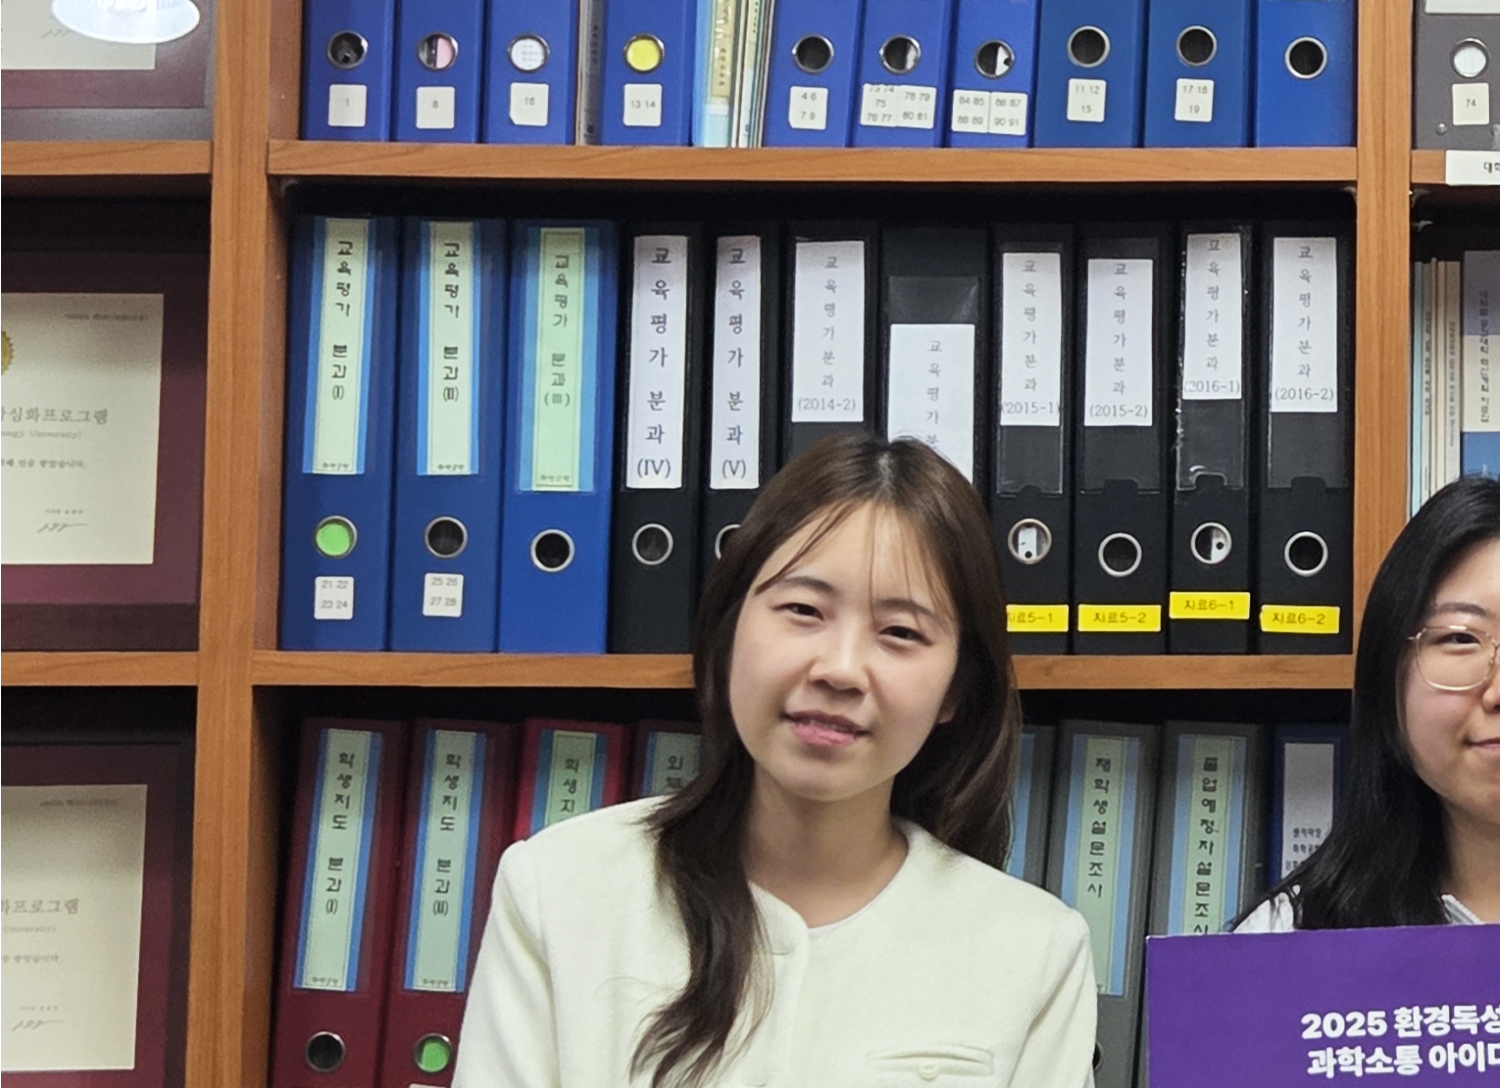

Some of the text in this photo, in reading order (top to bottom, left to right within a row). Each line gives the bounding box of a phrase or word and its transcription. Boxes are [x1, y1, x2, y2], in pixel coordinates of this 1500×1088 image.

[335, 239, 355, 318] 교육평가
[443, 241, 462, 319] 교육평가
[552, 254, 571, 328] 교육평가
[648, 247, 672, 368] 교육평가
[727, 247, 746, 368] 교육평가
[1183, 379, 1241, 394] (2016-1)
[1273, 387, 1335, 402] (2016-2)
[0, 405, 109, 426] 심화프로그램
[797, 398, 857, 413] (2014-2)
[1001, 401, 1060, 416] (2015-1)
[1088, 403, 1149, 419] (2015-2)
[1092, 611, 1148, 625] 자료5-2
[1271, 612, 1327, 626] 자료6-2
[331, 752, 356, 831] 학생지도
[439, 753, 463, 833] 학생지도
[1301, 1011, 1388, 1041] 2025
[1306, 1044, 1424, 1079] 과학소통
